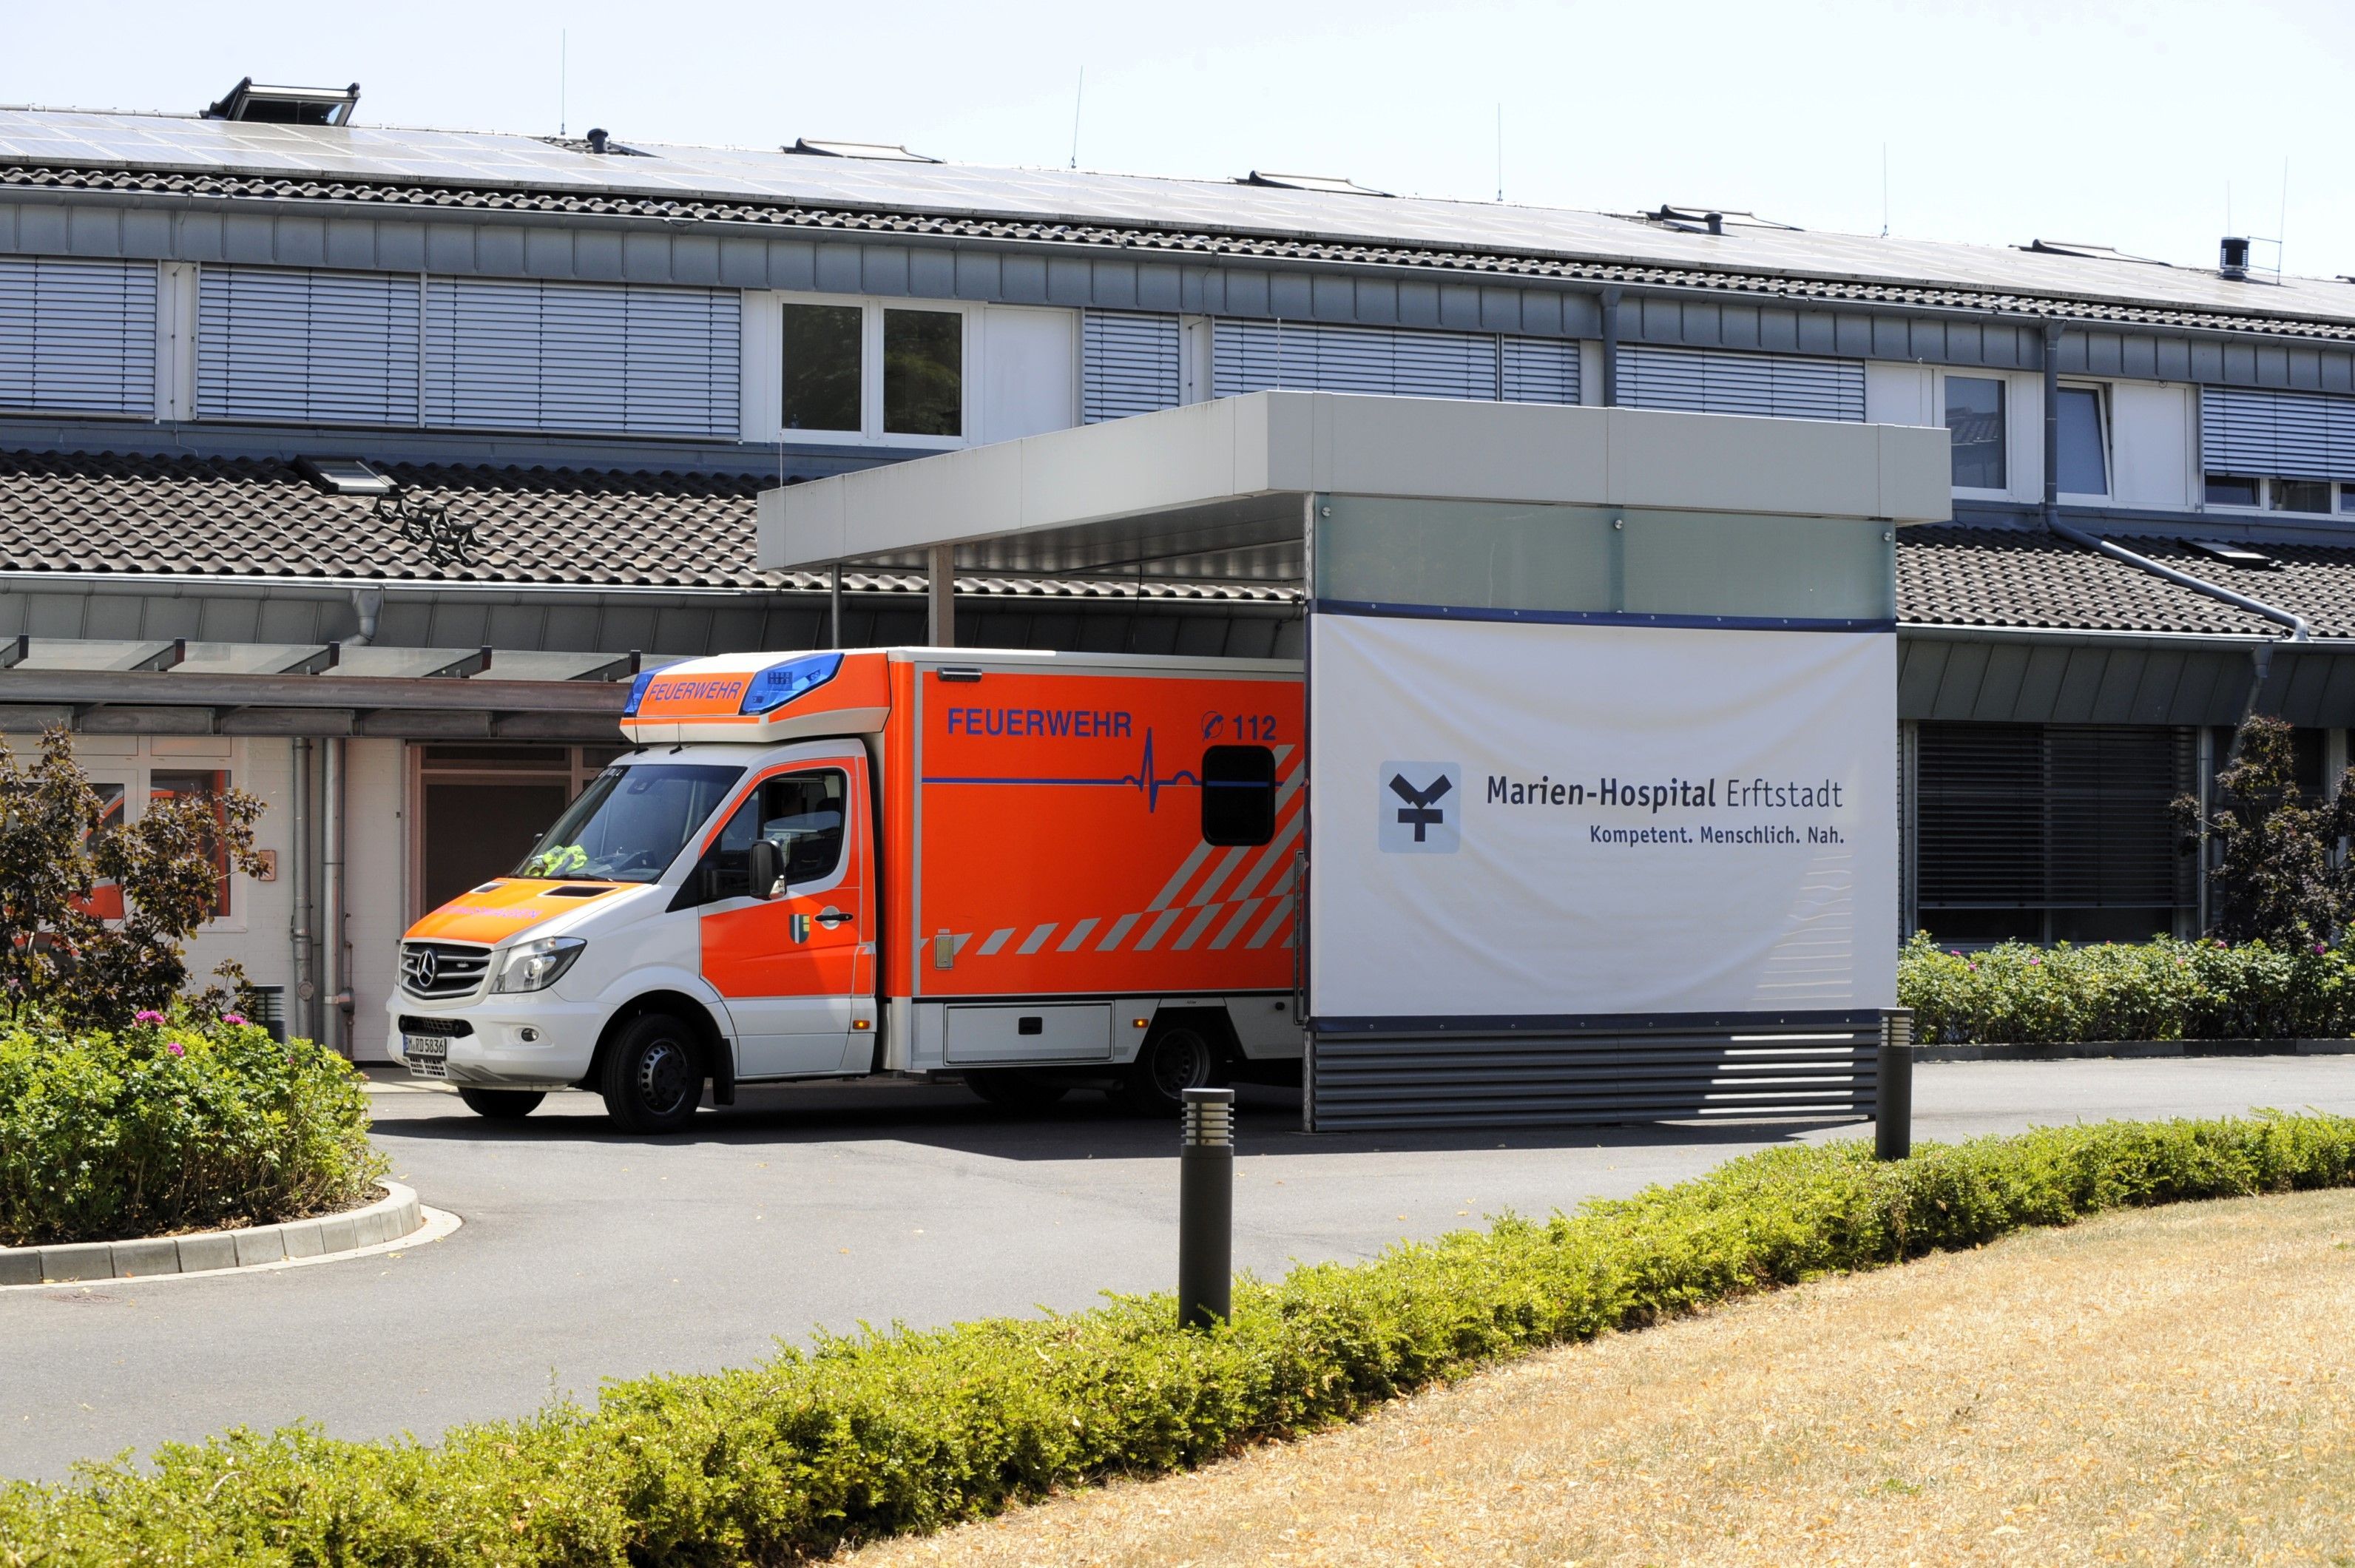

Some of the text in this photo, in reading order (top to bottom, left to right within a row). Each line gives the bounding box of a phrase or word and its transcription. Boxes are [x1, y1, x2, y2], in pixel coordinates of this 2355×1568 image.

[646, 681, 742, 702] FEUERWEHR
[947, 707, 1132, 737] FEUERWEHR
[1233, 714, 1277, 740] 112
[1487, 775, 1843, 814] Marien-Hospital Erftstadt
[1590, 825, 1844, 848] Kompetent. Menschlich. Nah.
